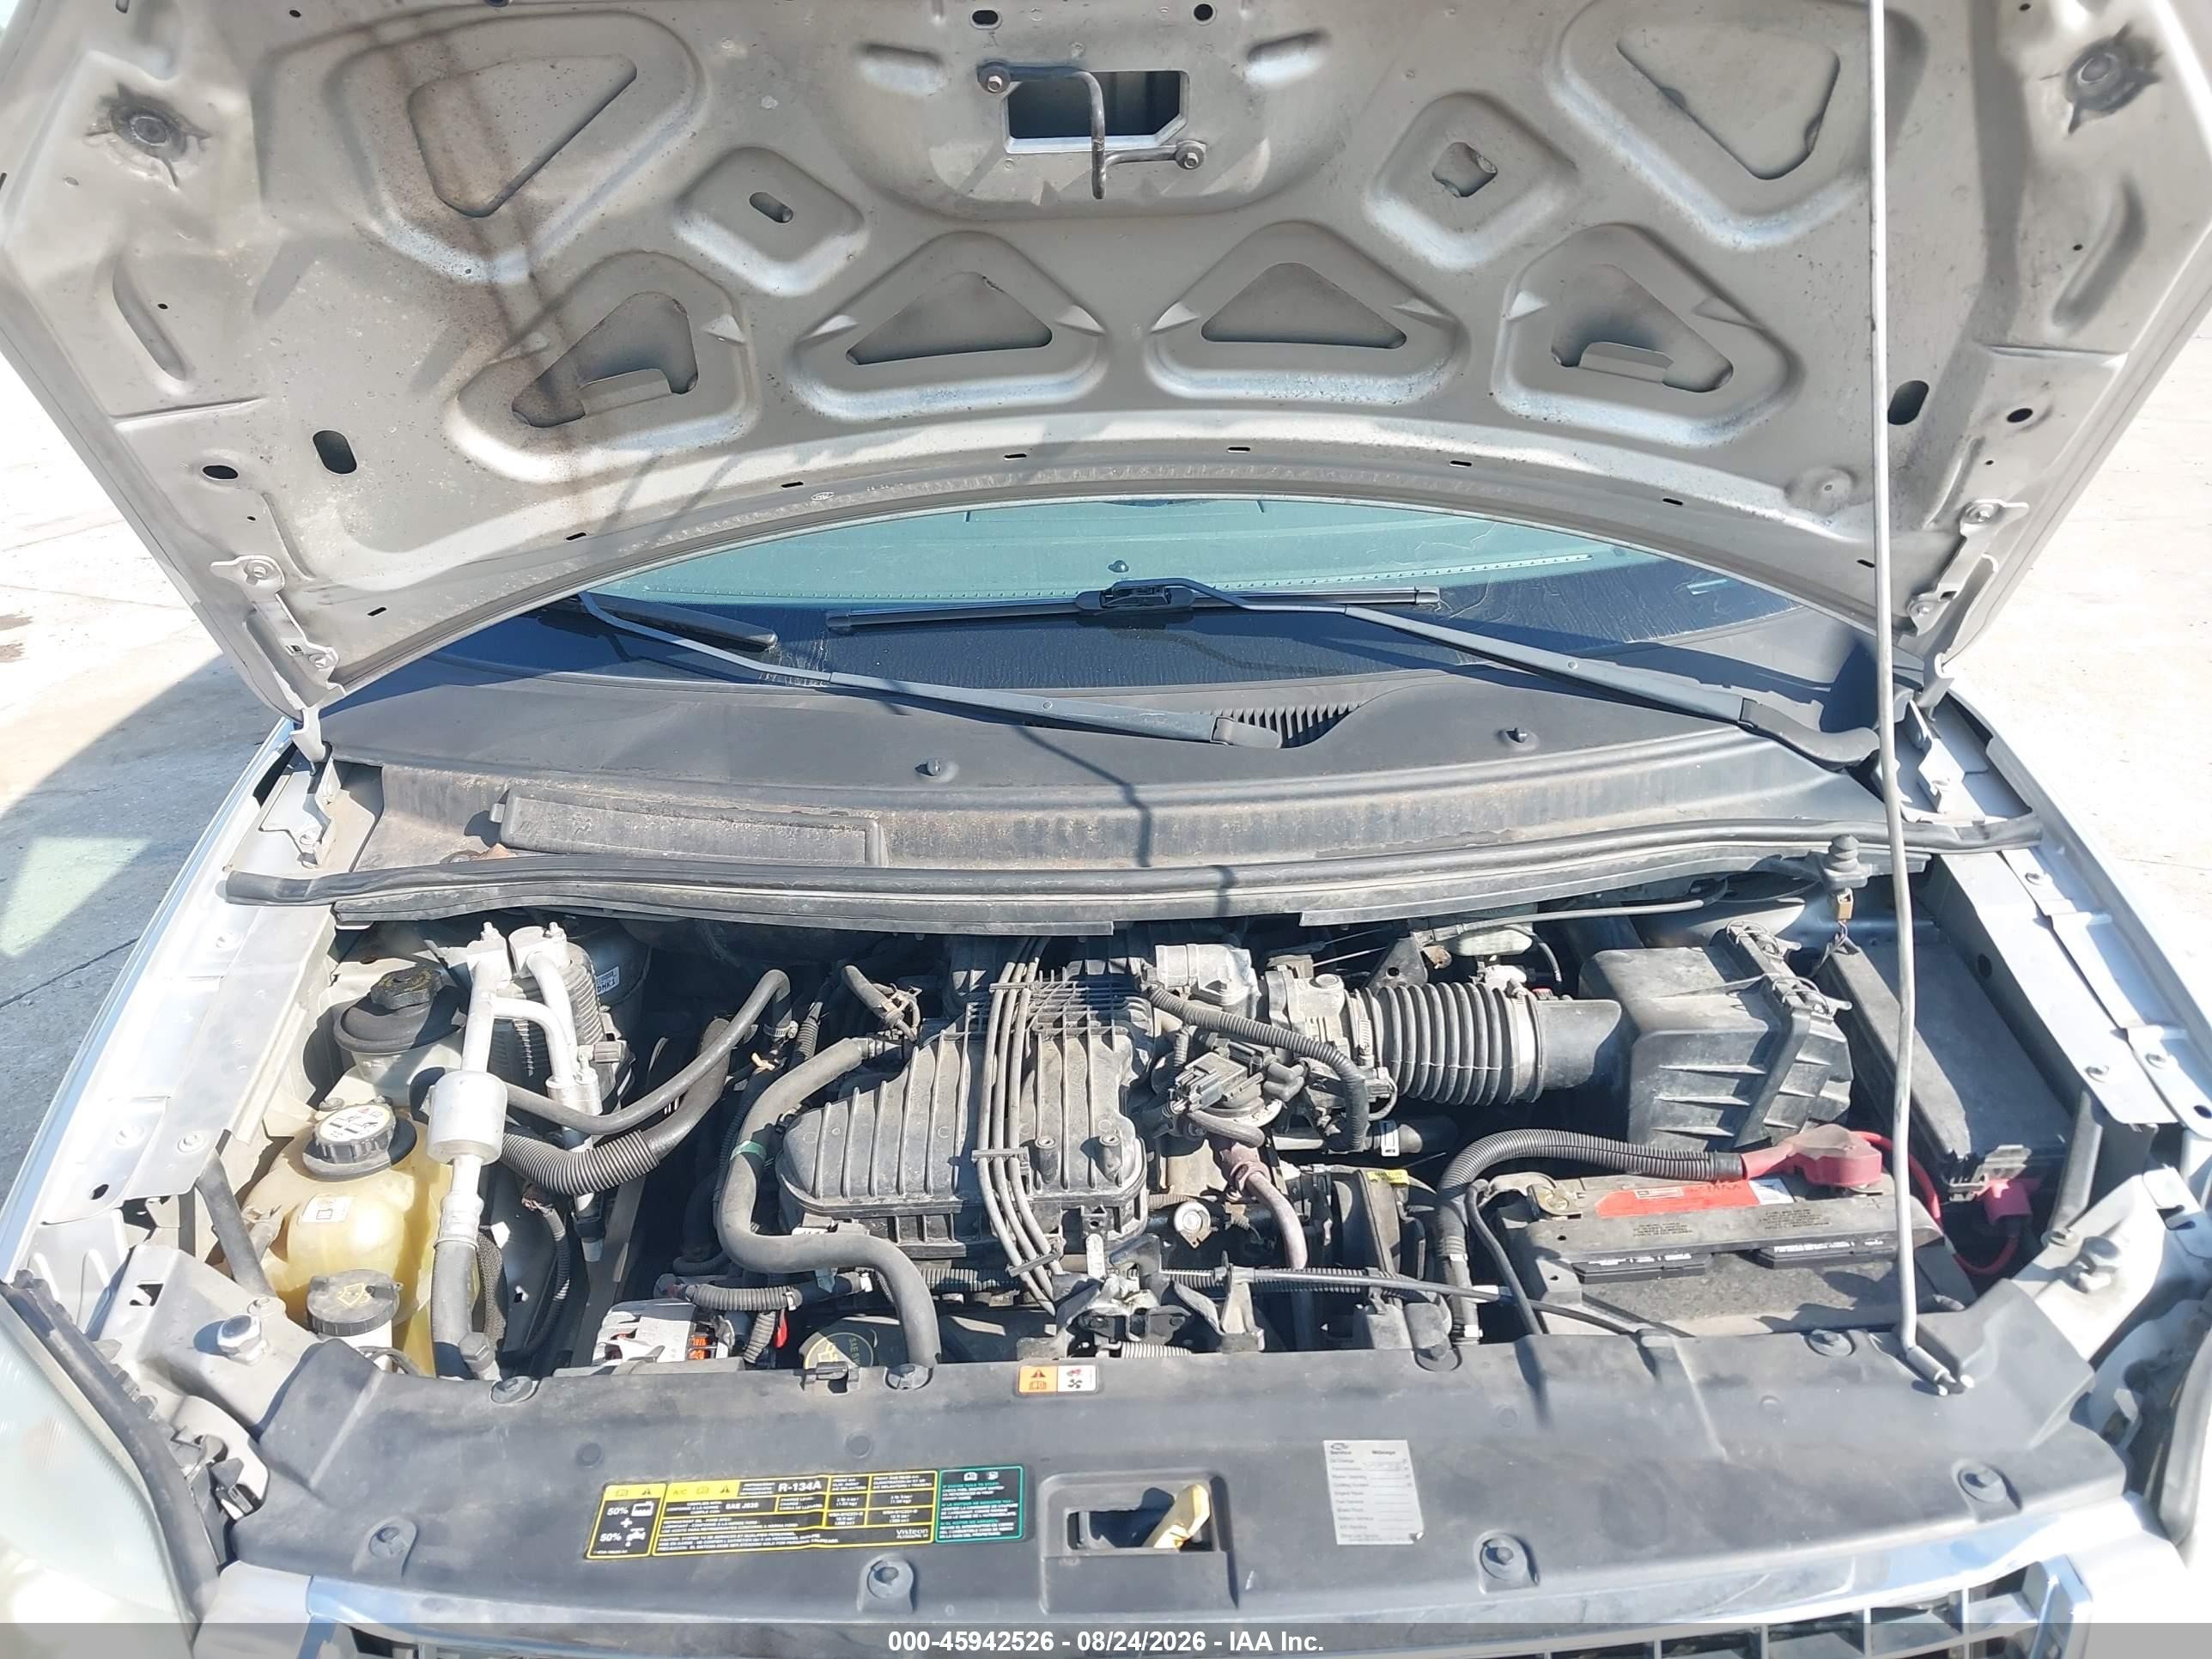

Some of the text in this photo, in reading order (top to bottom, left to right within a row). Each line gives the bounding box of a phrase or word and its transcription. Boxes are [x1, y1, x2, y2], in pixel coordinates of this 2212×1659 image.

[777, 1480, 823, 1492] R-134A
[606, 1506, 629, 1516] 50%
[599, 1532, 623, 1543] 50%
